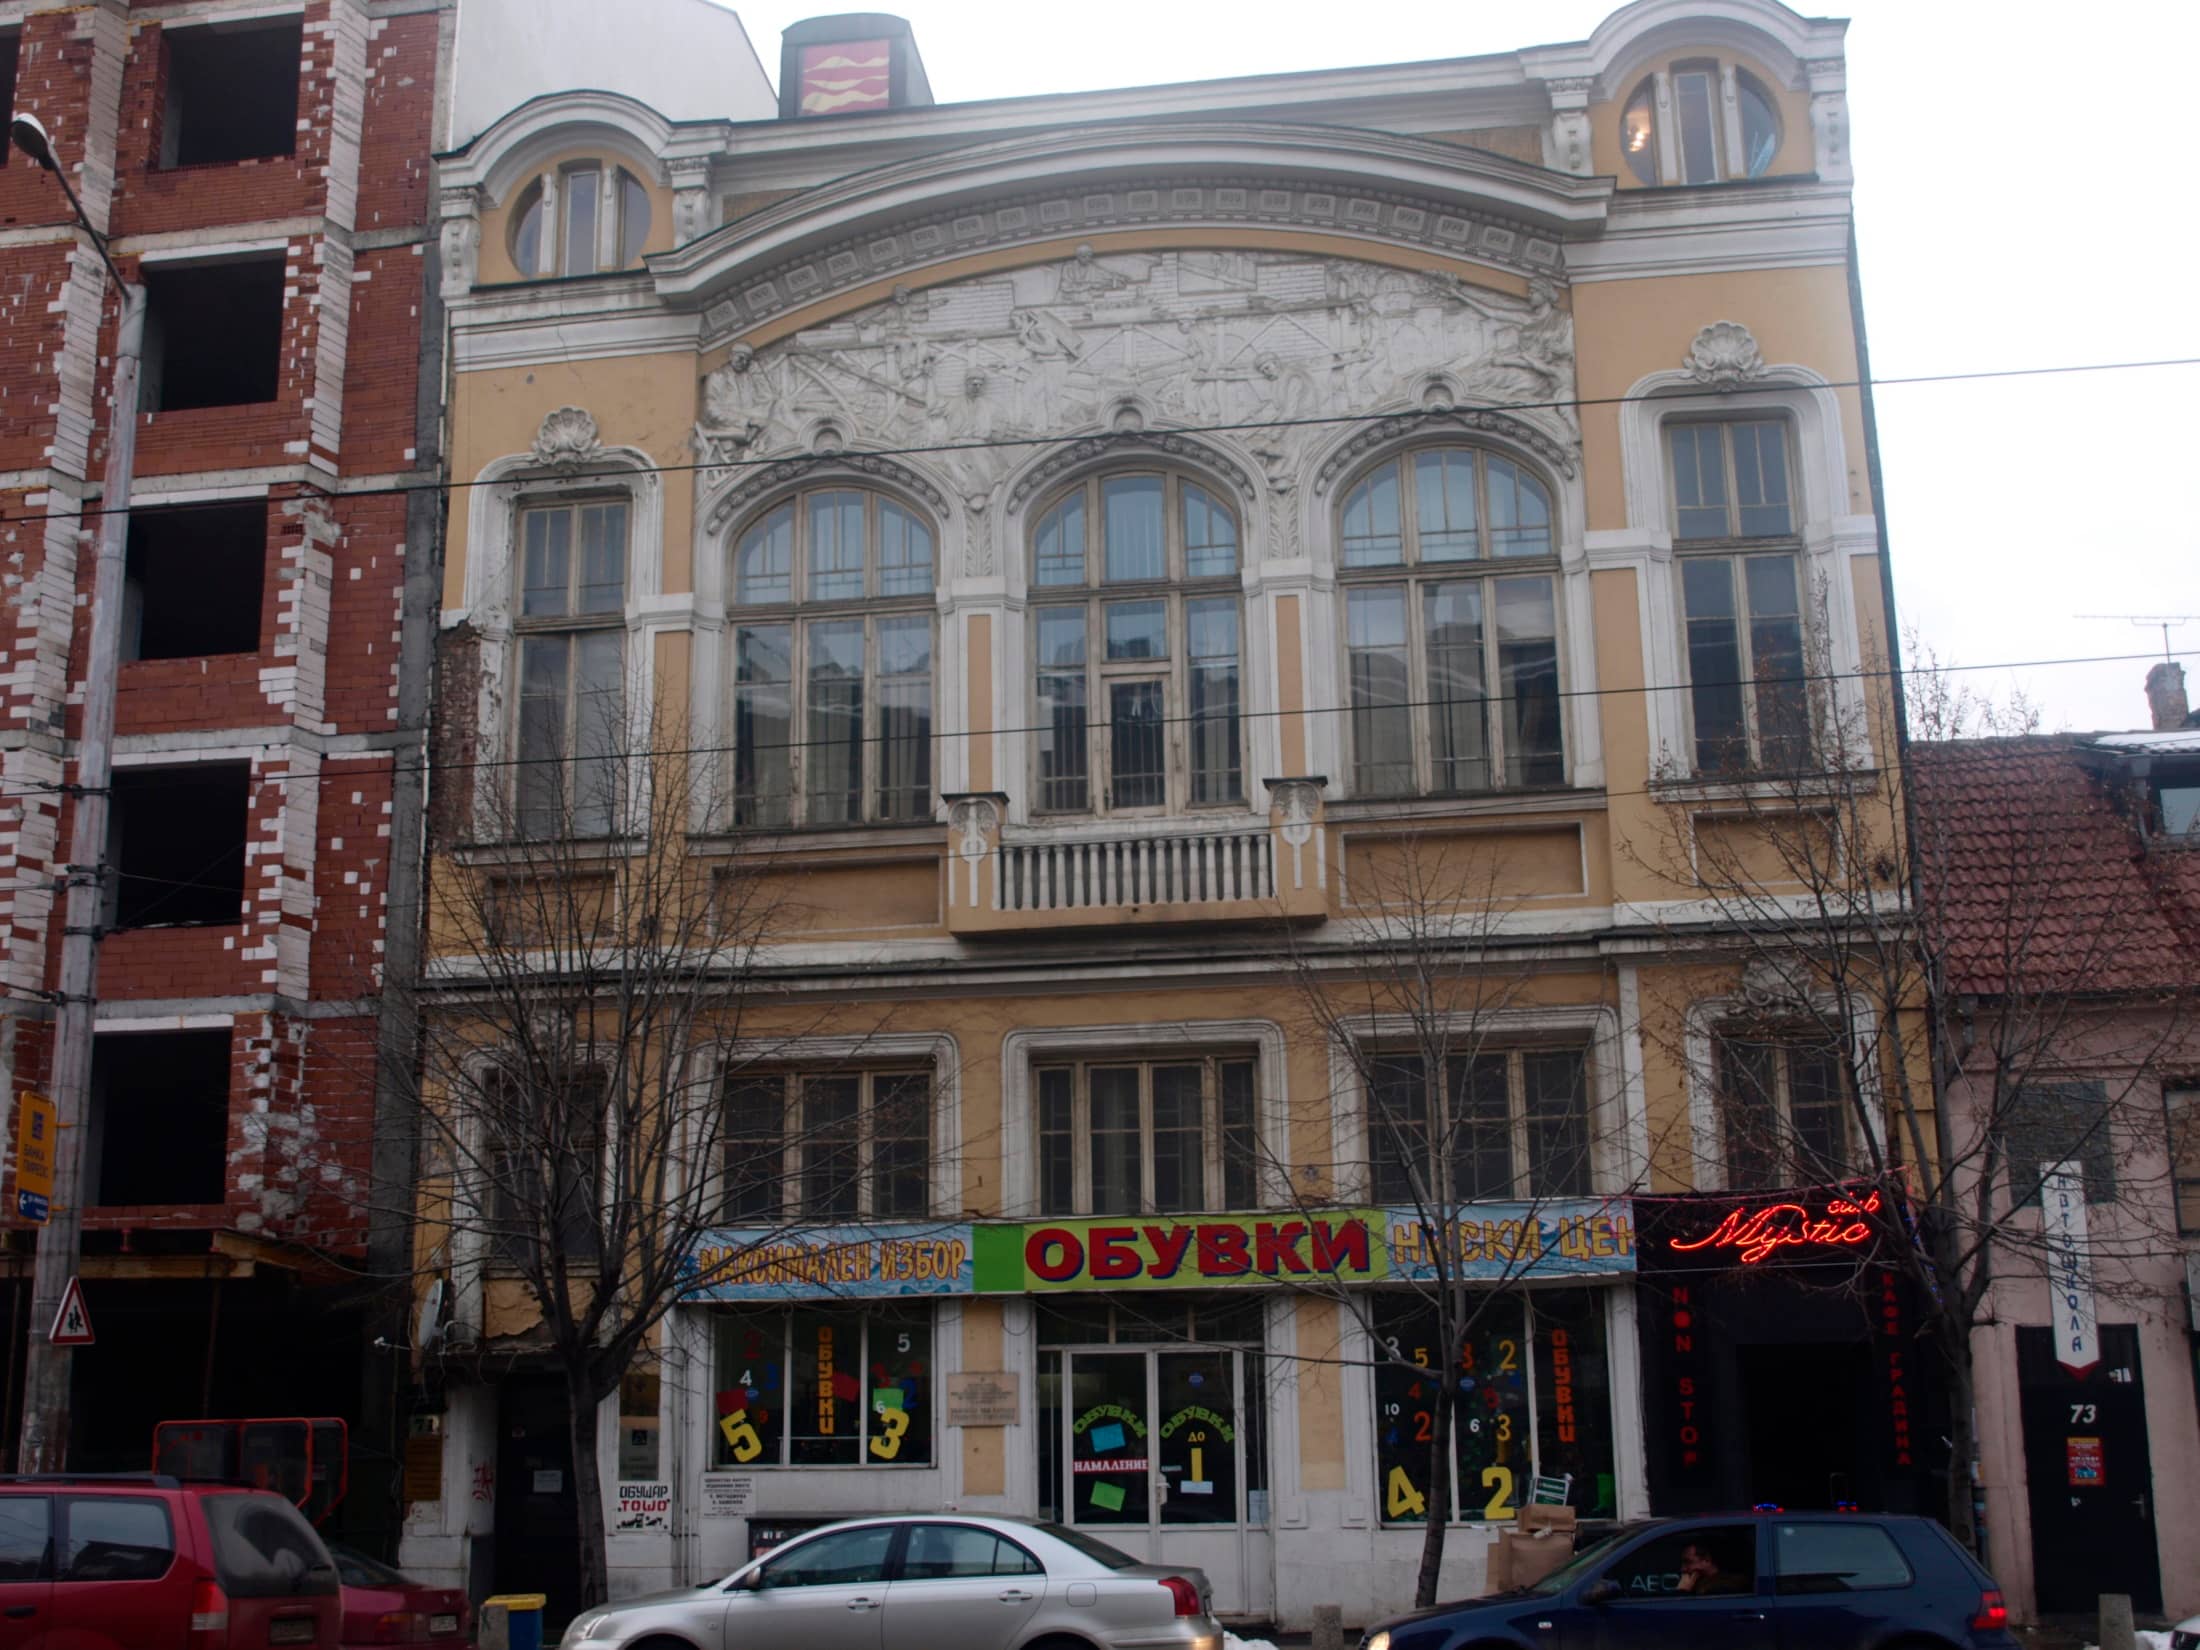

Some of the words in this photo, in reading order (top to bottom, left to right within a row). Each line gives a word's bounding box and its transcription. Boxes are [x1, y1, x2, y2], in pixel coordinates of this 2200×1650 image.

[1024, 1218, 1370, 1281] ОБУВКИ
[1669, 1203, 1870, 1263] Mystic
[700, 1240, 871, 1287] МАКСИМАЛЕН
[880, 1239, 966, 1281] ИЗБОР
[2058, 1174, 2082, 1353] АВТОШКОЛА
[897, 1333, 911, 1353] 5
[1413, 1346, 1429, 1369] 5
[1498, 1338, 1518, 1370] 2
[740, 1368, 752, 1386] 4
[817, 1325, 836, 1436] ОБУВКИ
[1551, 1328, 1577, 1445] ОБУВКИ
[875, 1400, 887, 1414] 6
[1073, 1404, 1147, 1439] ОБУВКИ
[1160, 1405, 1234, 1443] ОБУВКИ
[1384, 1403, 1400, 1416] 10
[1679, 1376, 1699, 1471] STOP
[2069, 1403, 2097, 1424] 73
[720, 1408, 763, 1463] 5
[869, 1407, 911, 1461] 3
[1187, 1431, 1206, 1442] ДО
[1413, 1410, 1433, 1442] 2
[1470, 1418, 1481, 1433] 6
[1495, 1413, 1512, 1441] 3
[1074, 1459, 1149, 1472] НАМАЛЕНИЕ
[1387, 1464, 1426, 1519] 4
[1481, 1466, 1516, 1520] 2
